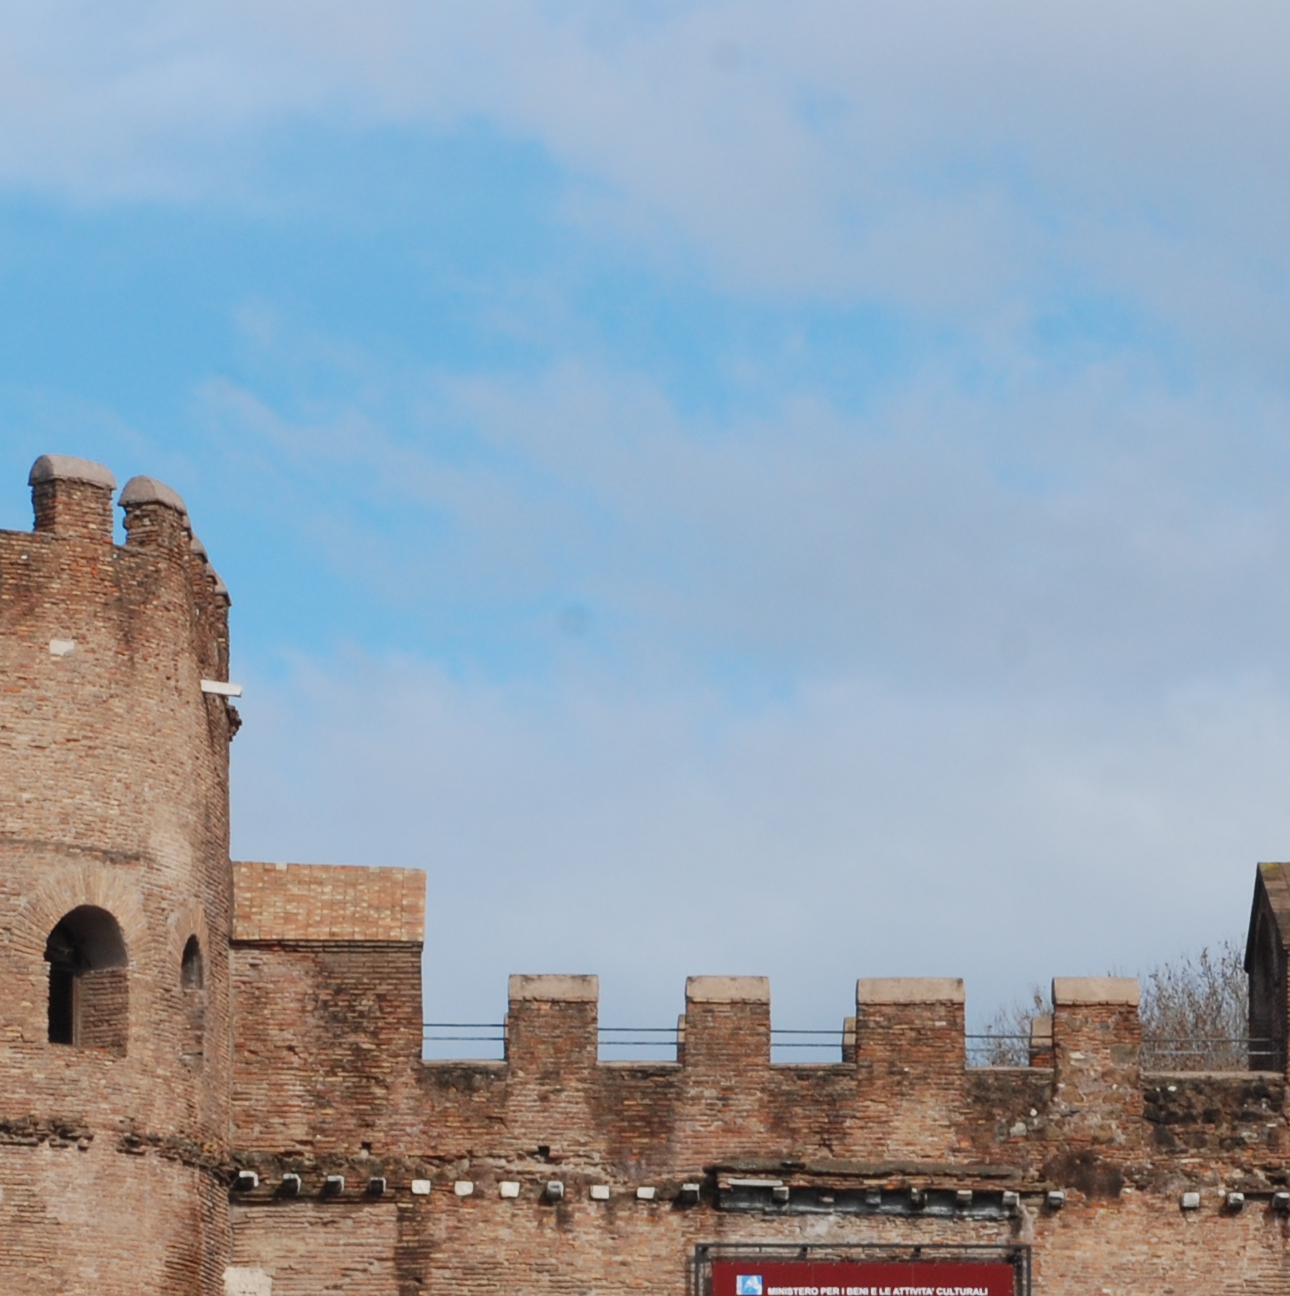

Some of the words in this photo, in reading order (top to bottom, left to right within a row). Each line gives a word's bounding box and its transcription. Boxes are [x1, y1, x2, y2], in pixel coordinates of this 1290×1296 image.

[766, 1286, 819, 1296] MINISTERO
[820, 1286, 840, 1296] PER
[846, 1286, 869, 1296] BENI
[870, 1286, 877, 1296] E
[878, 1286, 891, 1296] LE
[936, 1286, 988, 1296] CULTURALI
